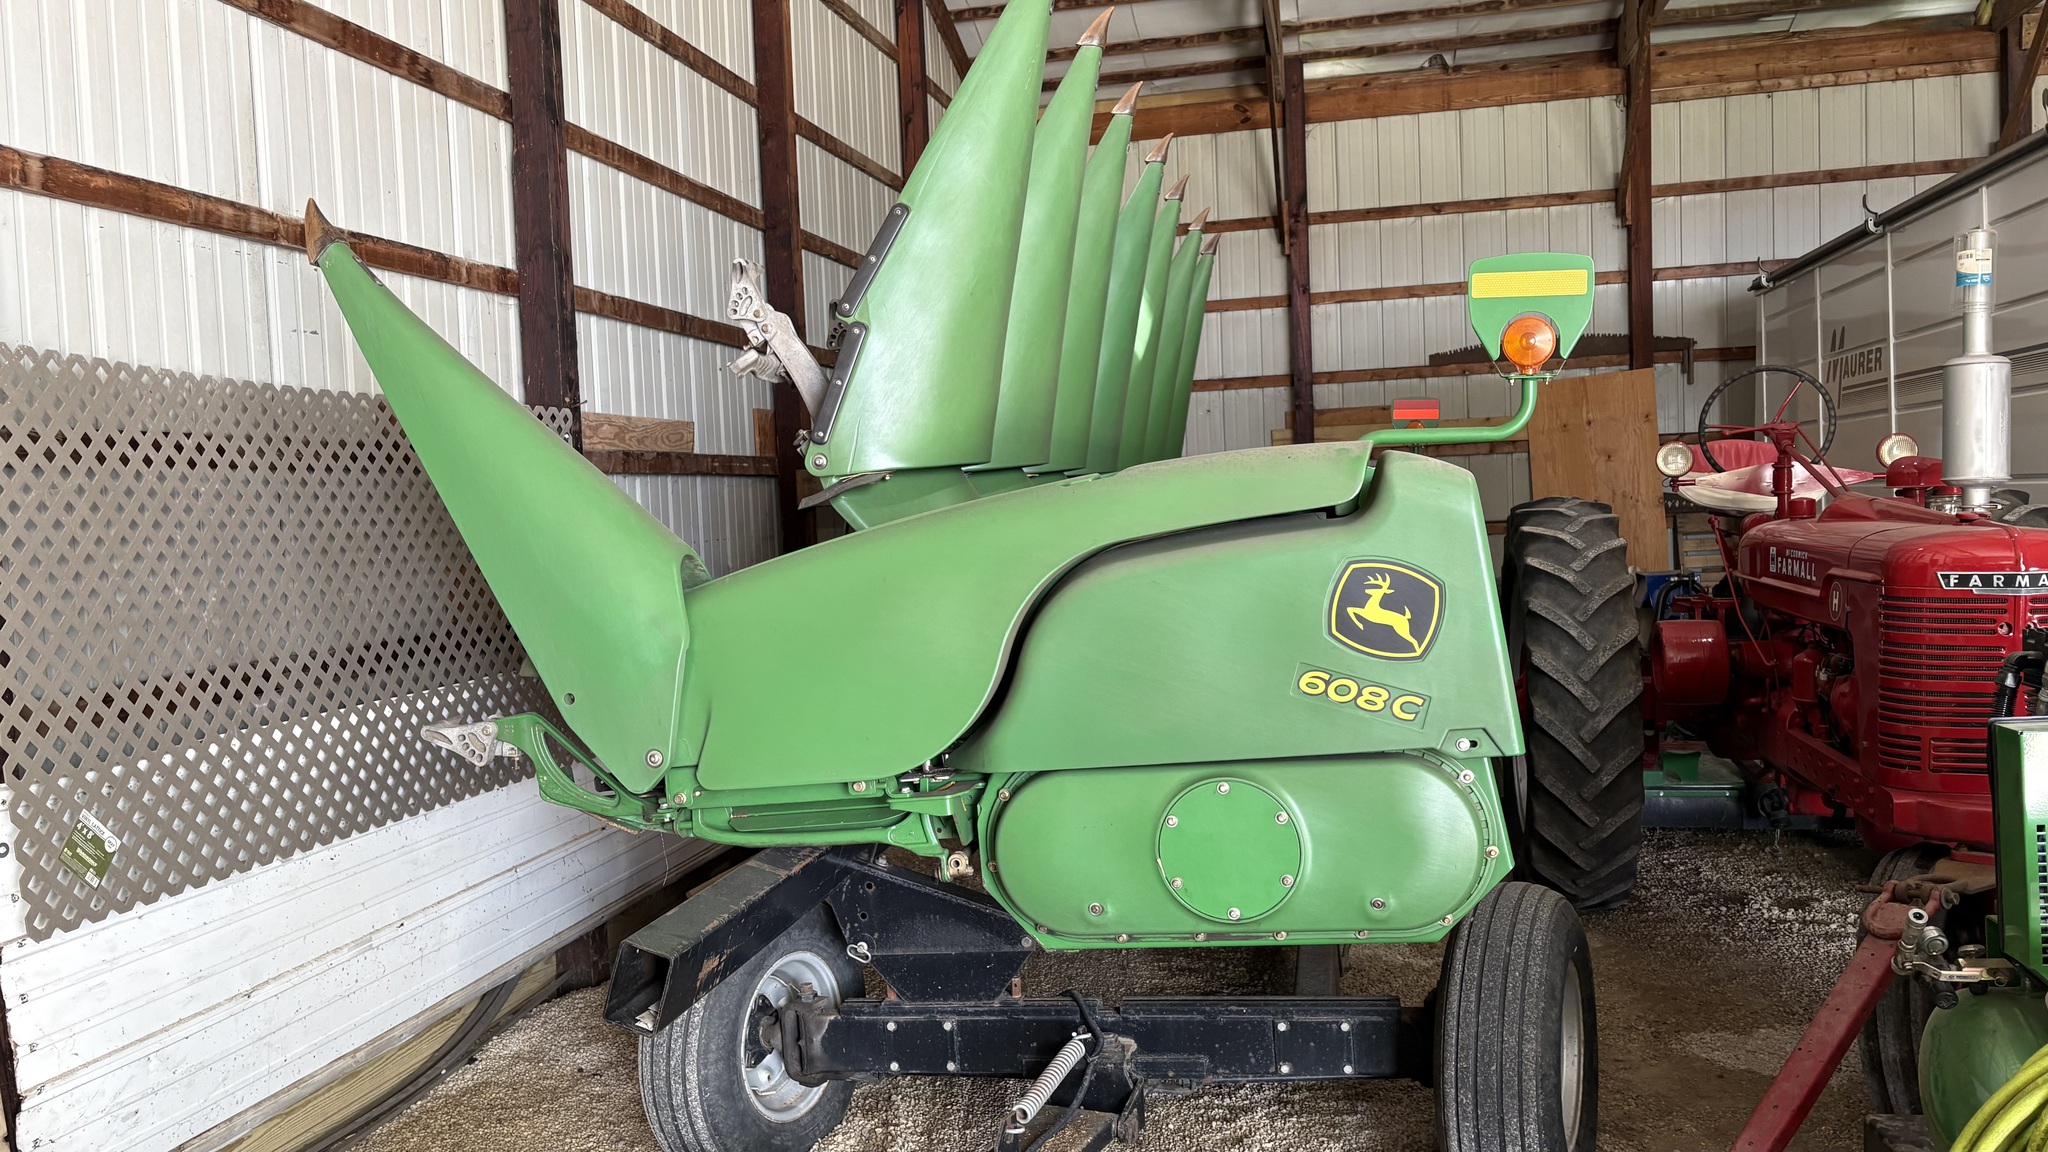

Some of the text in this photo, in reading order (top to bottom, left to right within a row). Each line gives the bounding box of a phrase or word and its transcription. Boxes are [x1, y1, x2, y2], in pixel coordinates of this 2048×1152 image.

[1826, 325, 1882, 410] MAURER
[1777, 556, 1816, 581] FARMALL
[1832, 590, 1840, 612] H
[1297, 669, 1426, 721] 608C
